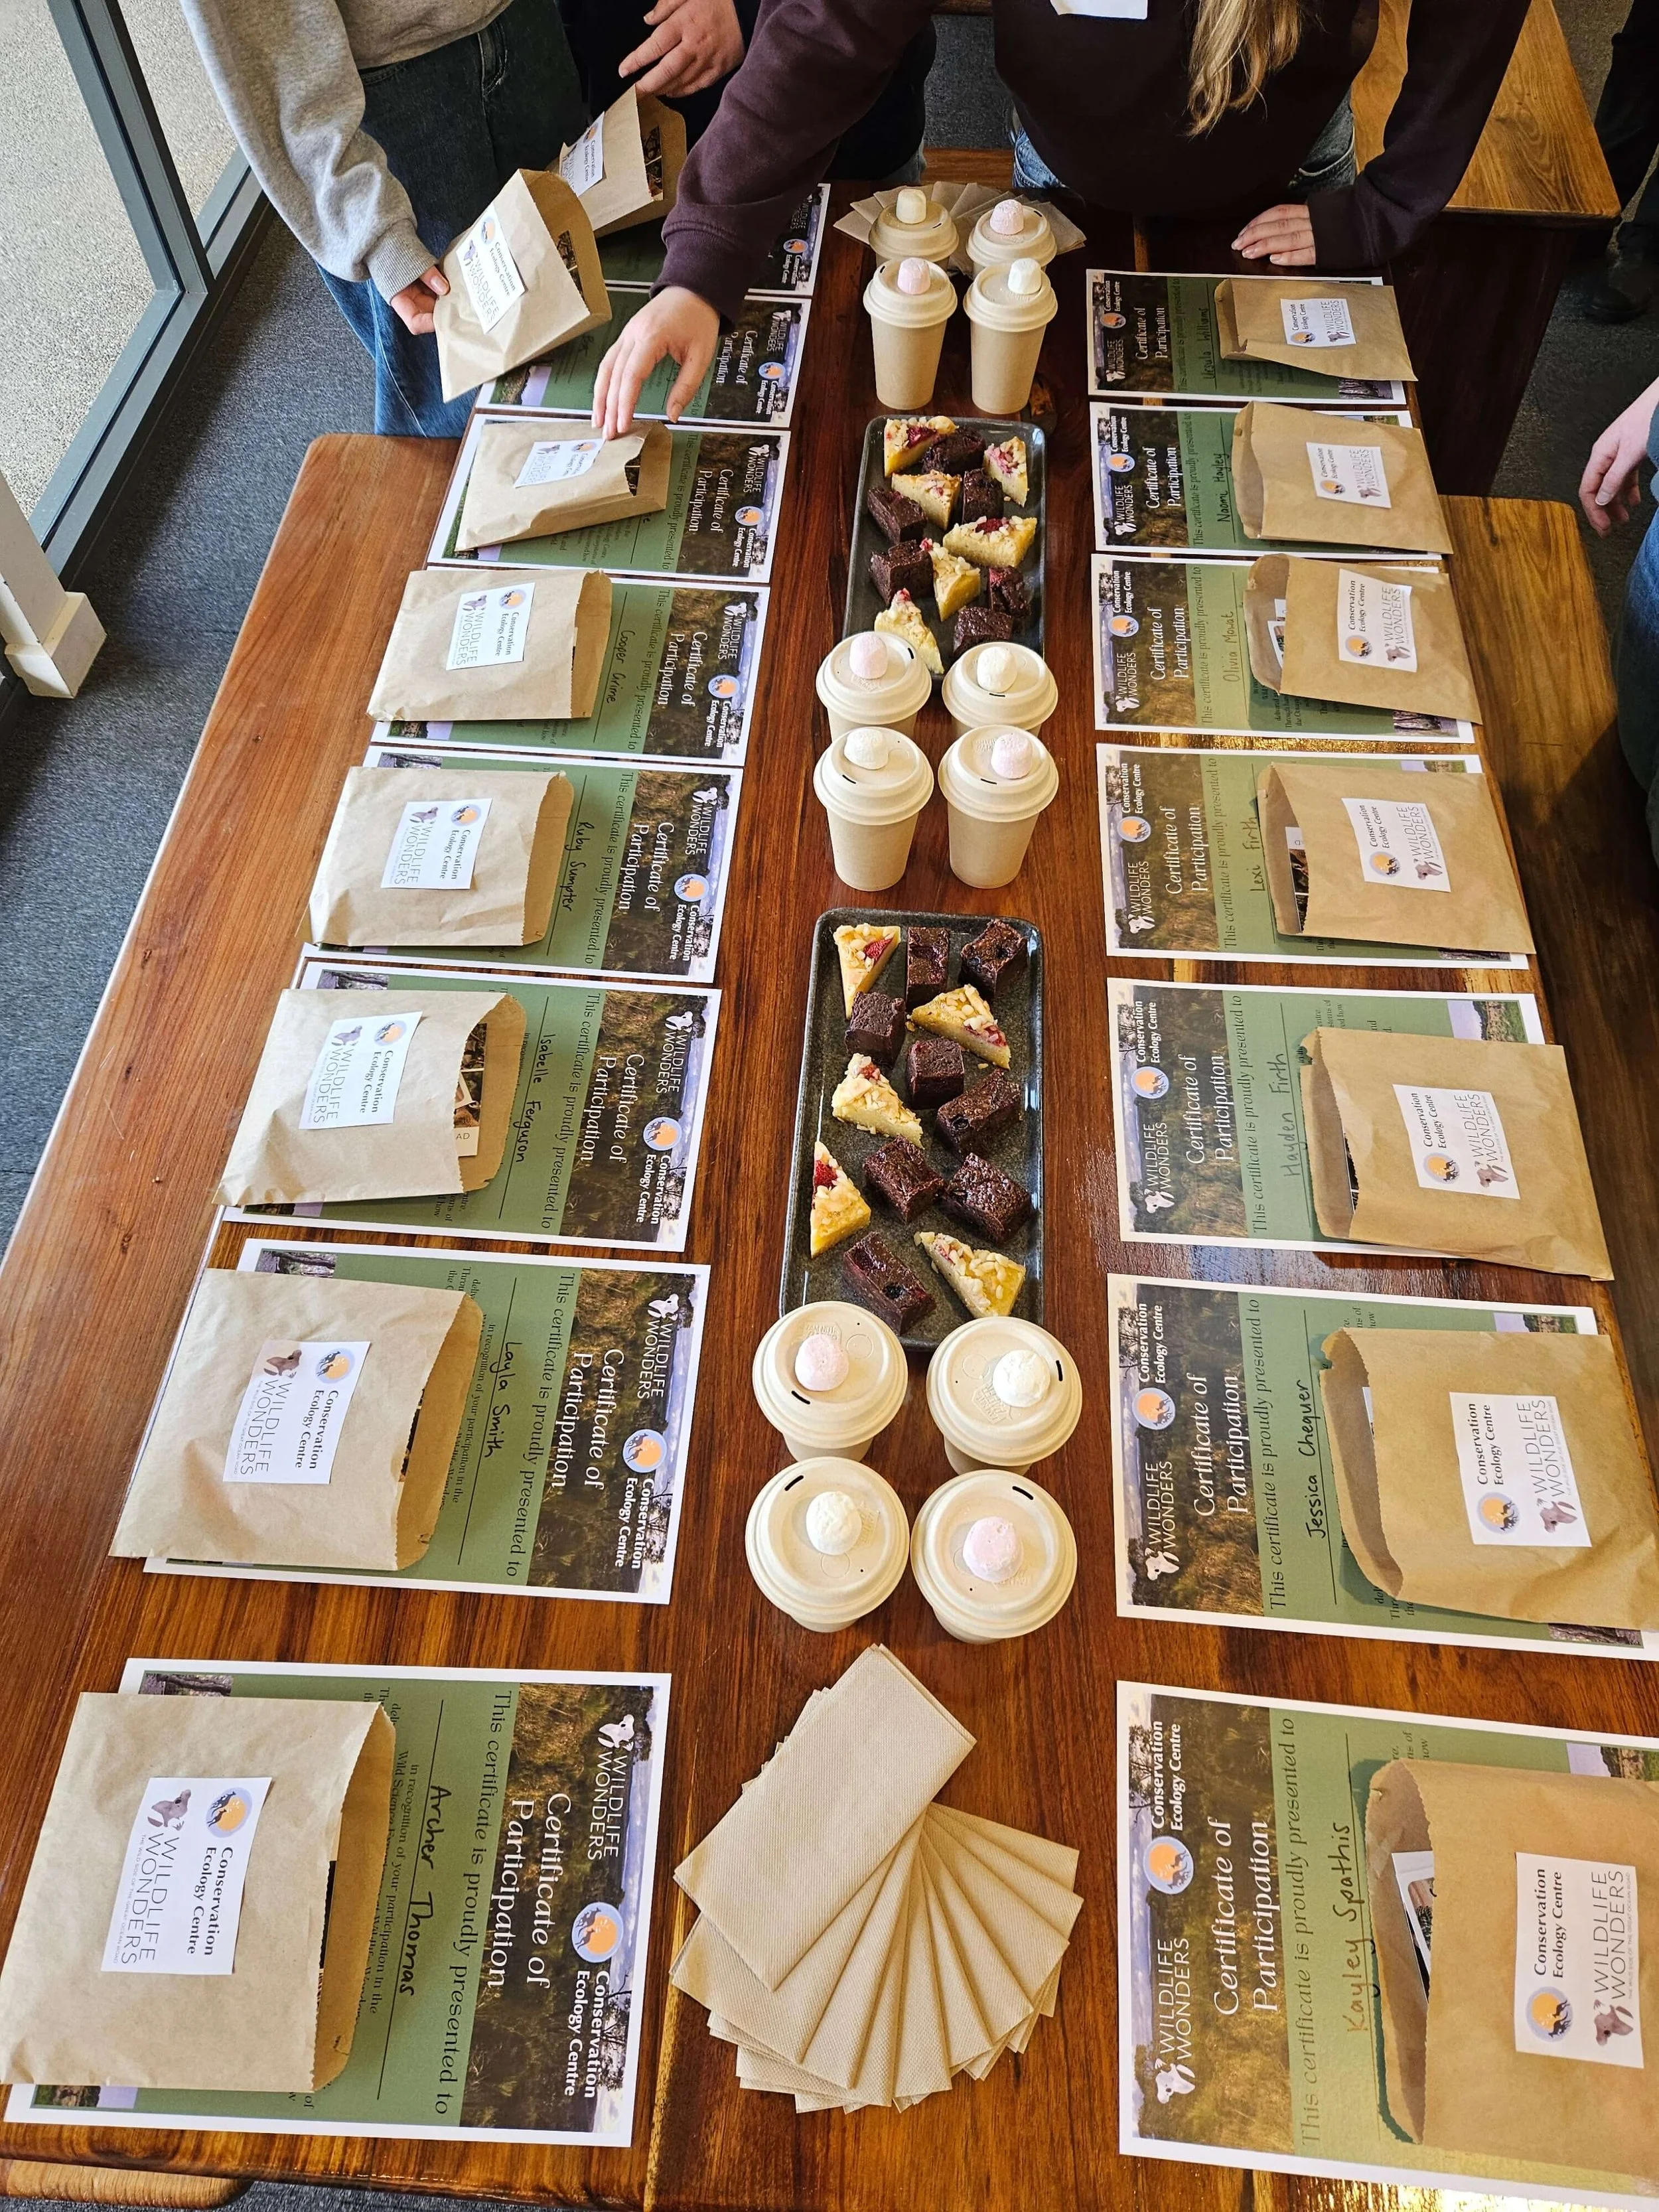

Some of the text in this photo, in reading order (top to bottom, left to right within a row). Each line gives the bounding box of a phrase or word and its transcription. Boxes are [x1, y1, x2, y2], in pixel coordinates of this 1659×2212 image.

[735, 330, 758, 385] Certificate of
[1133, 306, 1148, 359] Certificate of
[1154, 307, 1171, 358] Participation
[688, 470, 713, 531] Participation
[709, 469, 734, 533] Certificate of
[743, 456, 757, 492] WONDERS
[751, 457, 766, 492] WILDLIFE
[1141, 445, 1160, 508] Certificate of
[1165, 447, 1183, 506] Participation
[614, 630, 636, 664] Cooper
[657, 632, 685, 705] Participation
[680, 631, 707, 707] Certificate of
[717, 616, 733, 659] WONDERS
[727, 618, 743, 658] WILDLIFE
[1146, 606, 1165, 680] Certificate of
[1172, 607, 1191, 678] Participation
[1220, 610, 1241, 682] Olivia Mowat
[559, 821, 595, 911] Ruby Sumpter
[618, 824, 650, 909] Participation
[644, 822, 674, 912] Certificate of
[684, 804, 703, 855] WONDERS
[695, 806, 713, 854] WILDLIFE
[1159, 805, 1183, 894] Certificate of
[1187, 806, 1209, 891] Participation
[1240, 816, 1265, 891] Lexi Firth
[669, 903, 687, 960] Ecology Centre
[682, 904, 699, 961] Conservation
[1132, 1000, 1146, 1063] Conservation
[1147, 1001, 1161, 1063] Ecology Centre
[512, 1033, 555, 1162] Isabelle Ferguson
[580, 1056, 616, 1161] Participation
[609, 1053, 644, 1163] Certificate of
[1177, 1053, 1204, 1163] Certificate of
[1210, 1055, 1234, 1160] Participation
[1265, 1053, 1312, 1179] Hayden Firth
[1411, 1092, 1433, 1147] Conservation
[1425, 1094, 1446, 1148] Ecology Centre
[1454, 1094, 1484, 1157] WILDLIFE
[1467, 1094, 1498, 1161] WONDERS
[1143, 1123, 1159, 1186] WILDLIFE
[1155, 1122, 1171, 1189] WONDERS
[636, 1320, 660, 1398] WONDERS
[650, 1323, 672, 1397] WILDLIFE
[1135, 1303, 1150, 1382] Conservation
[1152, 1304, 1167, 1383] Ecology Centre
[240, 1380, 279, 1474] WONDERS
[255, 1382, 292, 1471] WILDLIFE
[295, 1389, 324, 1467] Ecology Centre
[309, 1390, 338, 1469] Conservation
[484, 1341, 522, 1457] Layla Smith
[551, 1352, 593, 1487] Participation
[584, 1349, 624, 1490] Certificate of
[1222, 1375, 1250, 1512] Participation
[1186, 1372, 1215, 1516] Certificate of
[1246, 1299, 1286, 1609] This certificate is proudly presented to
[1295, 1379, 1326, 1538] Jessica Chequer
[614, 1477, 638, 1567] Ecology Centre
[631, 1477, 654, 1568] Conservation
[1145, 1462, 1161, 1544] WILDLIFE
[1159, 1461, 1176, 1548] WONDERS
[587, 1751, 613, 1860] WONDERS
[603, 1755, 627, 1857] WILDLIFE
[1149, 1721, 1164, 1828] Conservation
[1169, 1723, 1186, 1830] Ecology Centre
[121, 1832, 164, 1964] WONDERS
[139, 1836, 179, 1959] WILDLIFE
[187, 1846, 216, 1954] Ecology Centre
[204, 1846, 233, 1955] Conservation
[369, 1764, 419, 2014] in recognition of your participation in the
[399, 1785, 452, 1996] Archer Thomas
[435, 1690, 512, 2114] This certificate is proudly presented to
[487, 1799, 534, 1987] Participation
[526, 1793, 571, 1988] Certificate of
[1207, 1816, 1238, 2014] Certificate of
[1249, 1822, 1280, 2010] Participation
[1326, 1821, 1384, 2035] Kayley Spathis
[1532, 1868, 1548, 1976] Conservation
[1551, 1872, 1567, 1978] Ecology Centre
[1591, 1872, 1609, 1993] WILDLIFE
[1607, 1871, 1626, 2000] WONDERS
[564, 1970, 590, 2096] Ecology Centre
[584, 1970, 609, 2097] Conservation
[1157, 1939, 1175, 2053] WILDLIFE
[1173, 1937, 1192, 2059] WONDERS
